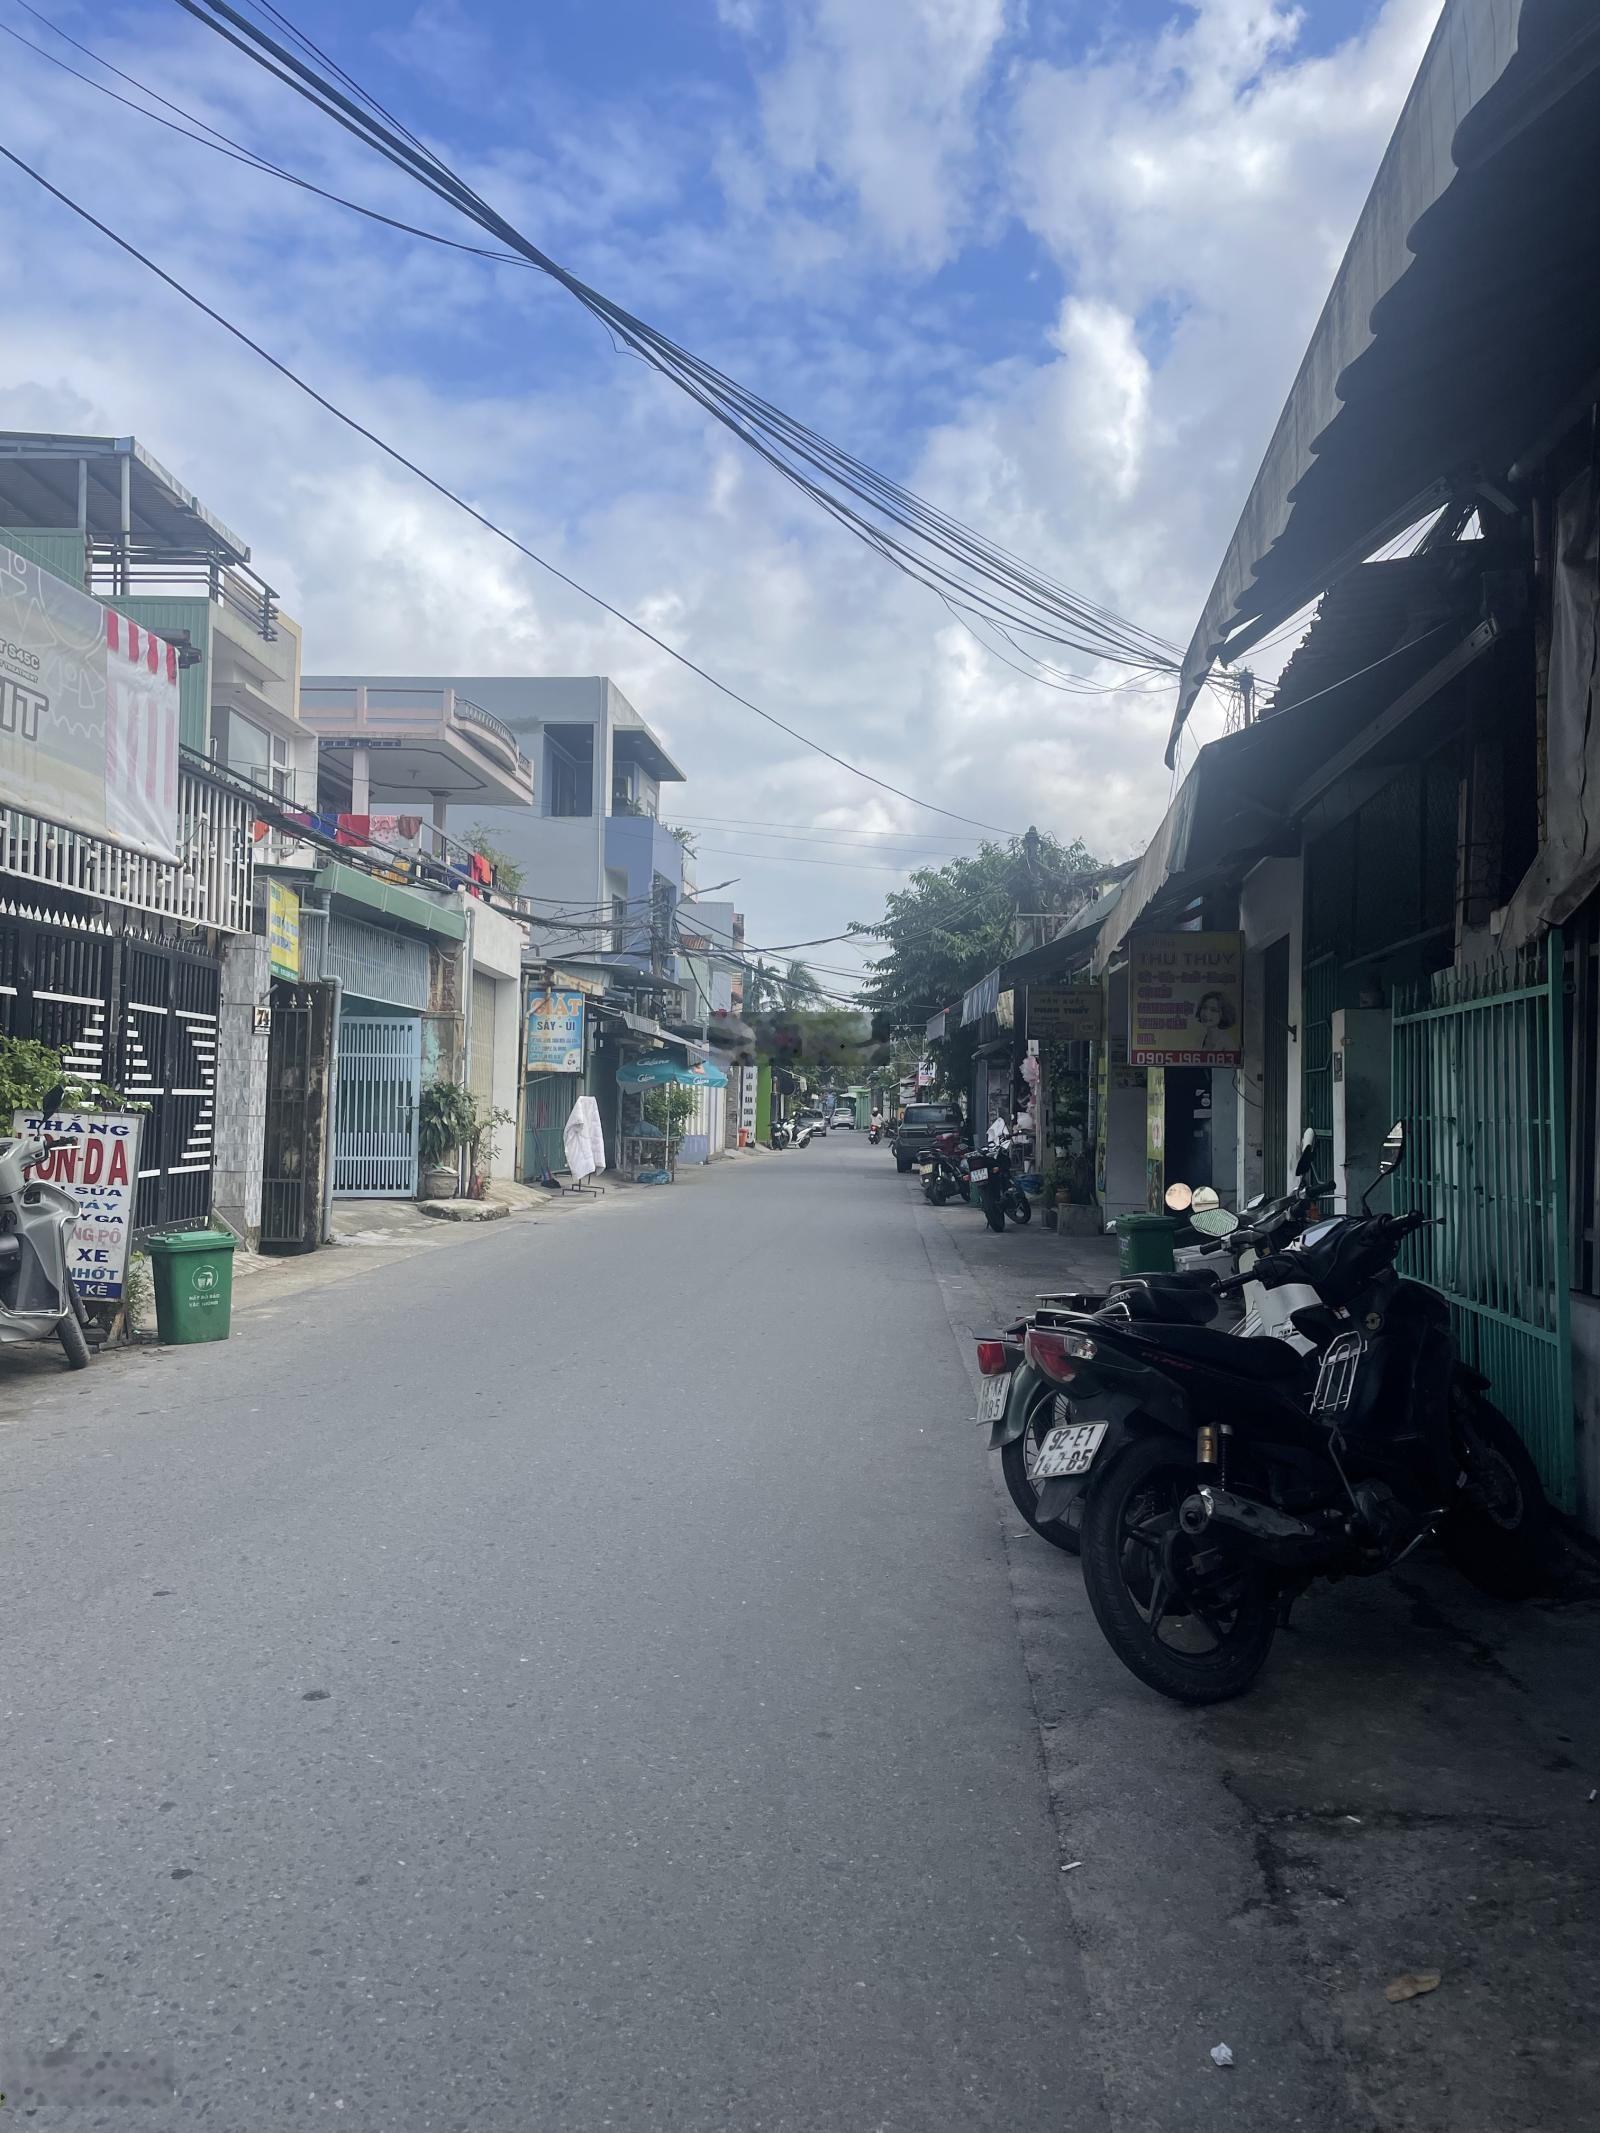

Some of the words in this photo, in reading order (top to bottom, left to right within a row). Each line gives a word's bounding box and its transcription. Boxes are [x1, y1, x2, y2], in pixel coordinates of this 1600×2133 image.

[8, 643, 40, 670] S45C
[24, 1115, 130, 1136] THẮNG
[76, 1248, 110, 1263] XE
